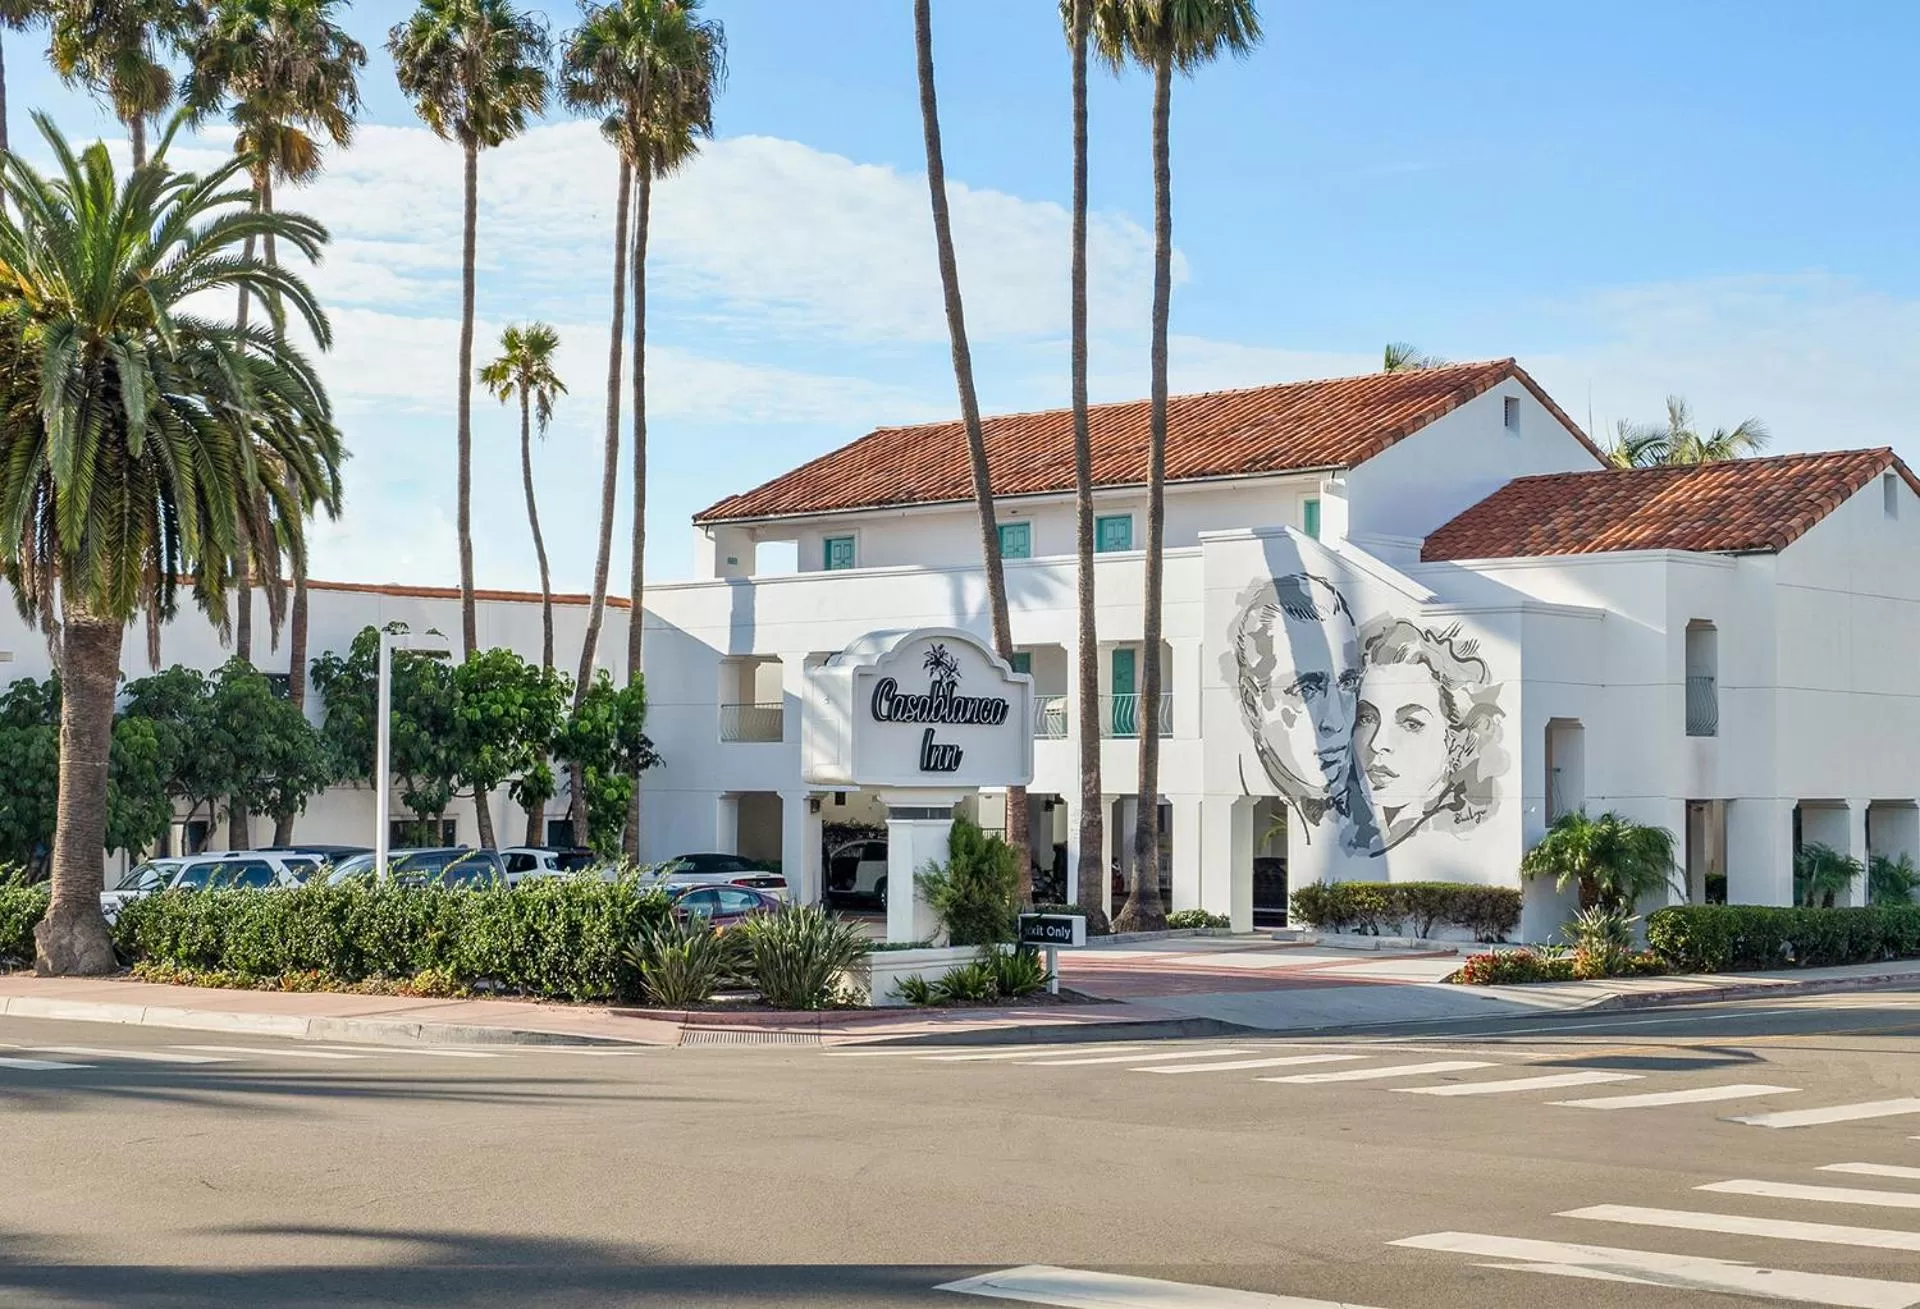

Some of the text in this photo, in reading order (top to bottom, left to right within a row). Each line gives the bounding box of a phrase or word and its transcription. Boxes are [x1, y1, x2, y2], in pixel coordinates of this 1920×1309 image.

[872, 677, 1009, 725] Casablanca
[920, 728, 963, 772] Inn
[1026, 924, 1071, 940] xit Only
